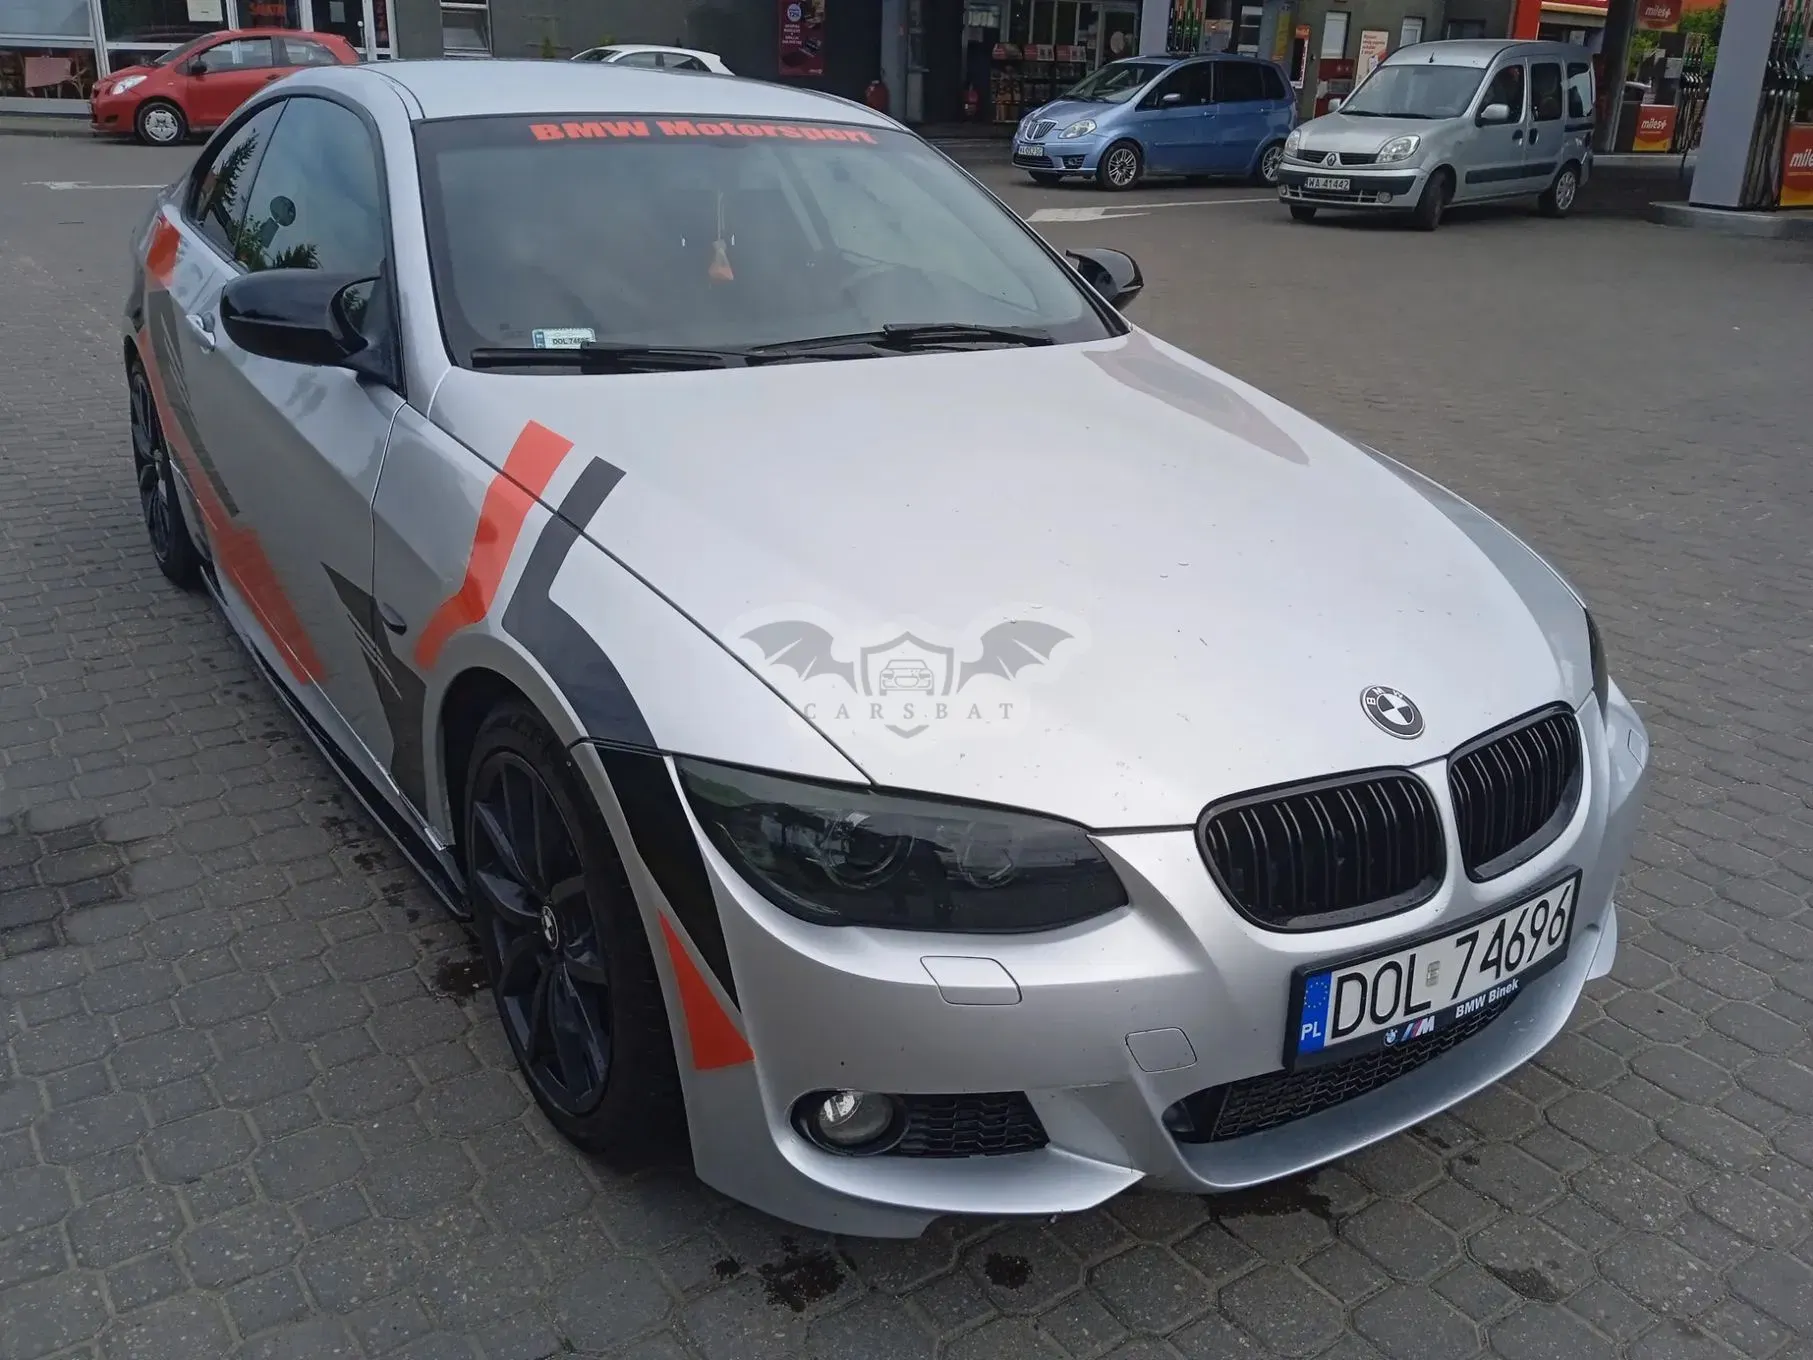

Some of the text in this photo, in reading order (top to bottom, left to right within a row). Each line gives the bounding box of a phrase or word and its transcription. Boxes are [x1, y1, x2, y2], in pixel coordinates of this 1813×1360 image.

[528, 120, 879, 145] BMW Motorsport
[1331, 885, 1571, 1040] DOL 74696
[1455, 978, 1519, 1019] BMW Binek
[1301, 1021, 1321, 1041] PL
